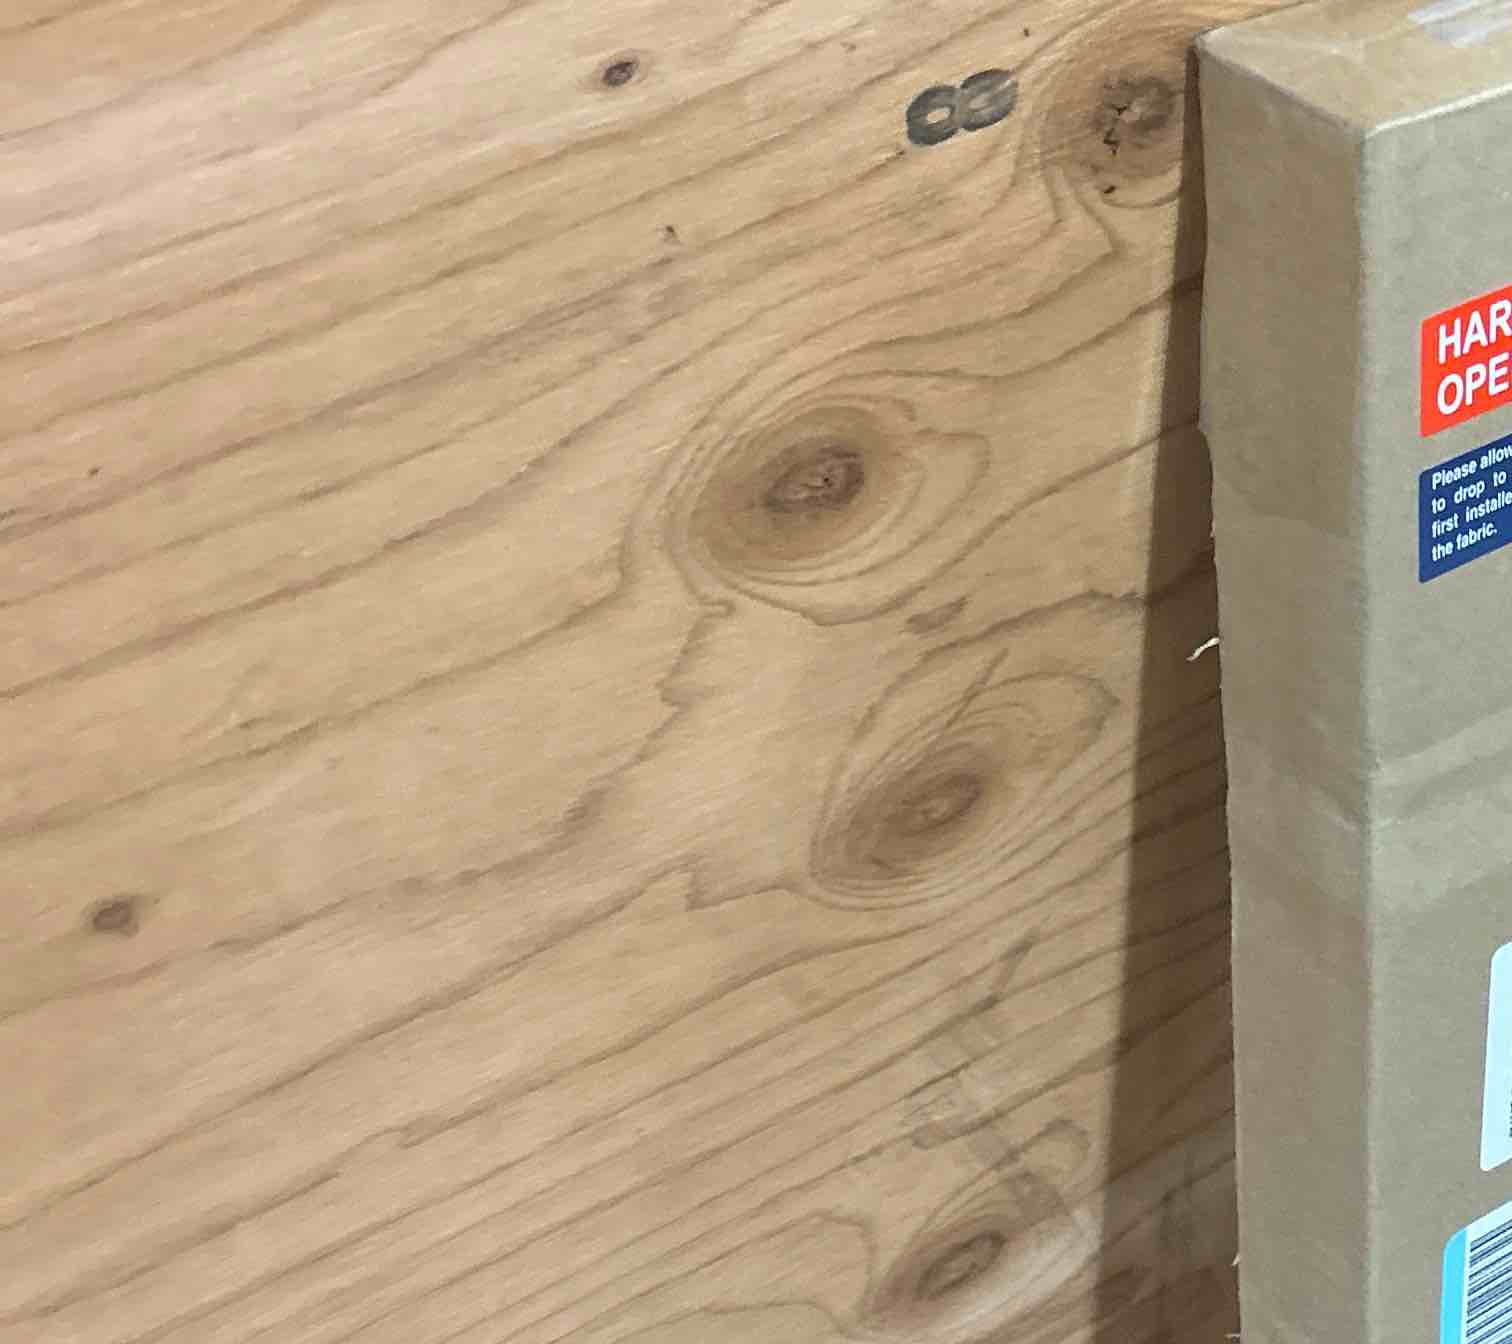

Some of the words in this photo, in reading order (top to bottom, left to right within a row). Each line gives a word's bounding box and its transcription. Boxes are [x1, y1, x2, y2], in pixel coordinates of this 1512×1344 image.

[1431, 460, 1478, 491] Please
[1431, 497, 1446, 514] to
[1453, 480, 1486, 504] drop
[1493, 471, 1507, 487] to
[1431, 513, 1459, 538] first
[1431, 541, 1454, 561] the
[1456, 522, 1498, 550] fabric.
